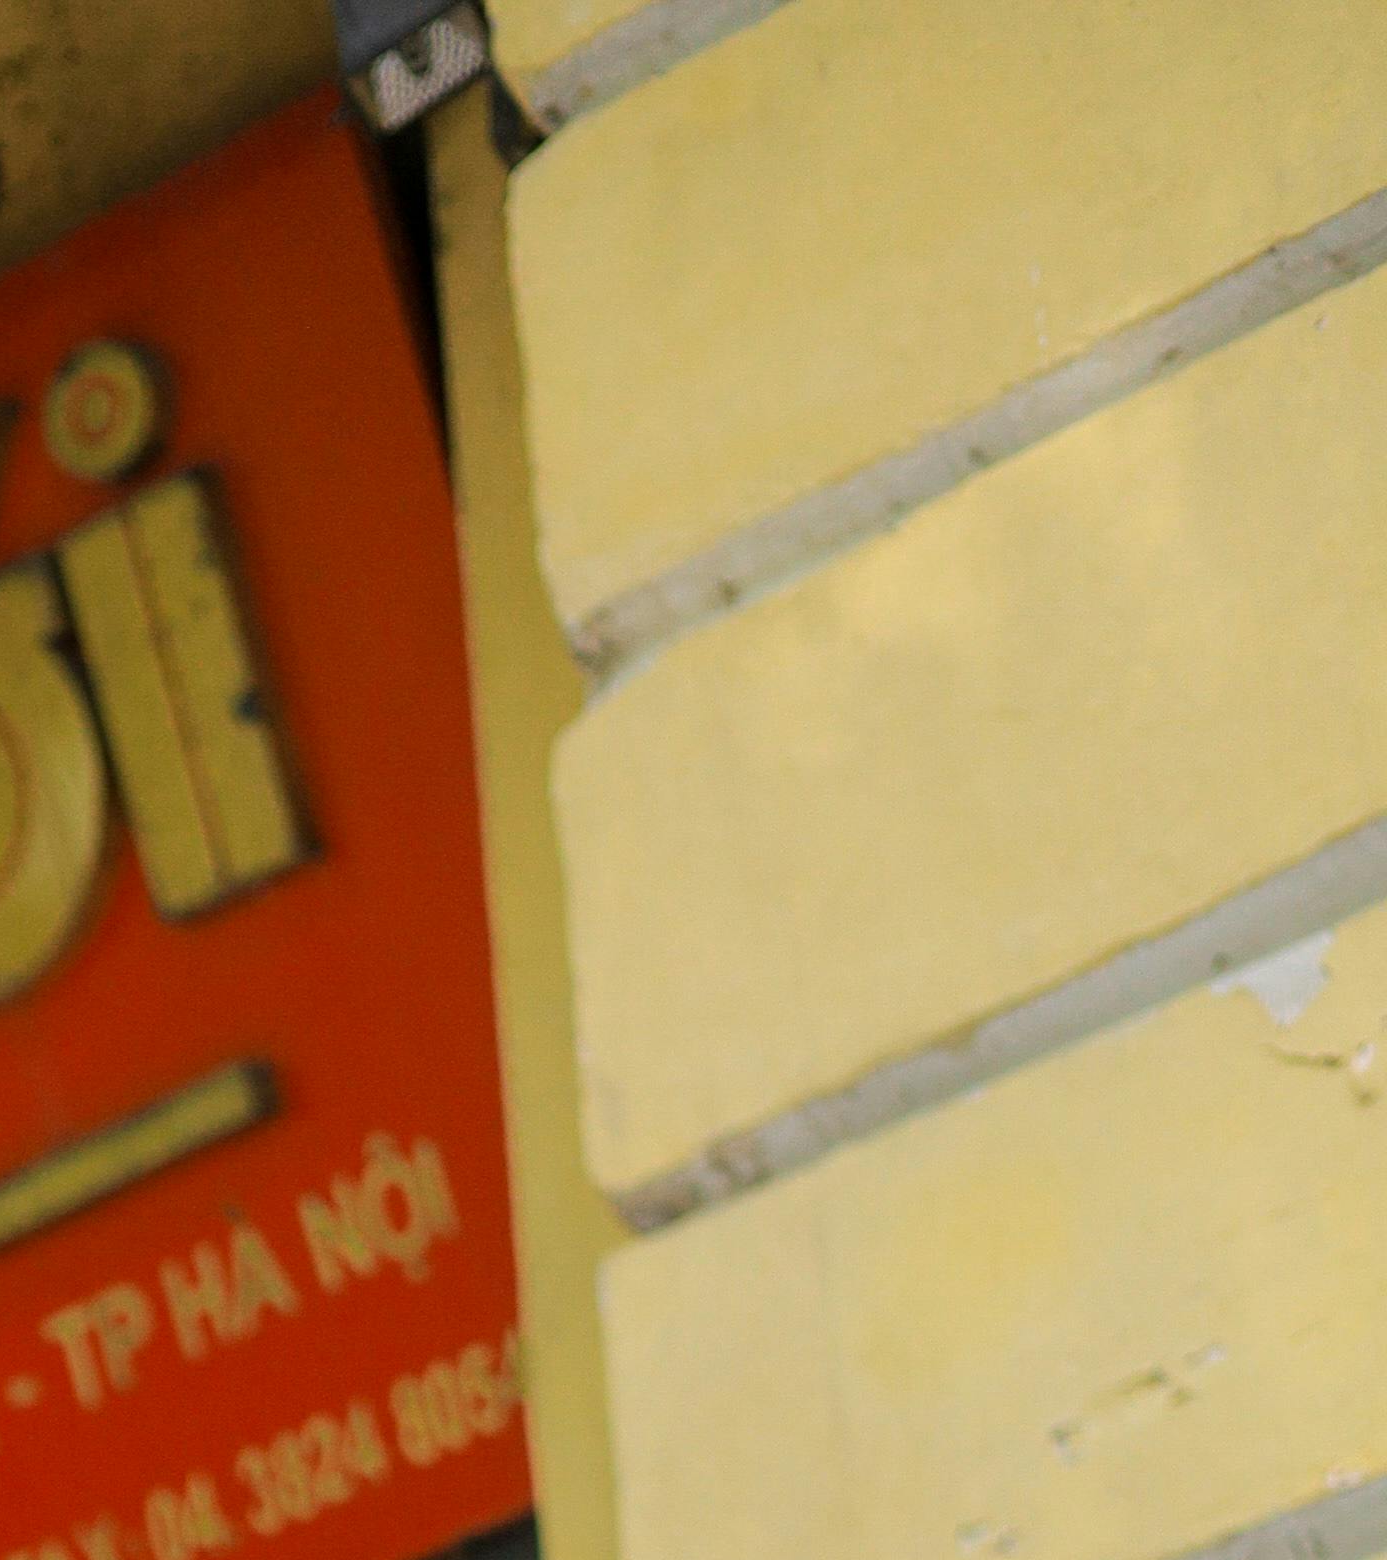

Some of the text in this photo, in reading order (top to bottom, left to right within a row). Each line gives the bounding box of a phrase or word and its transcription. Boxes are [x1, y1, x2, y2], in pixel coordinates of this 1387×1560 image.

[39, 1280, 154, 1412] TP
[157, 1200, 303, 1361] HÀ
[296, 1130, 461, 1294] NỘI
